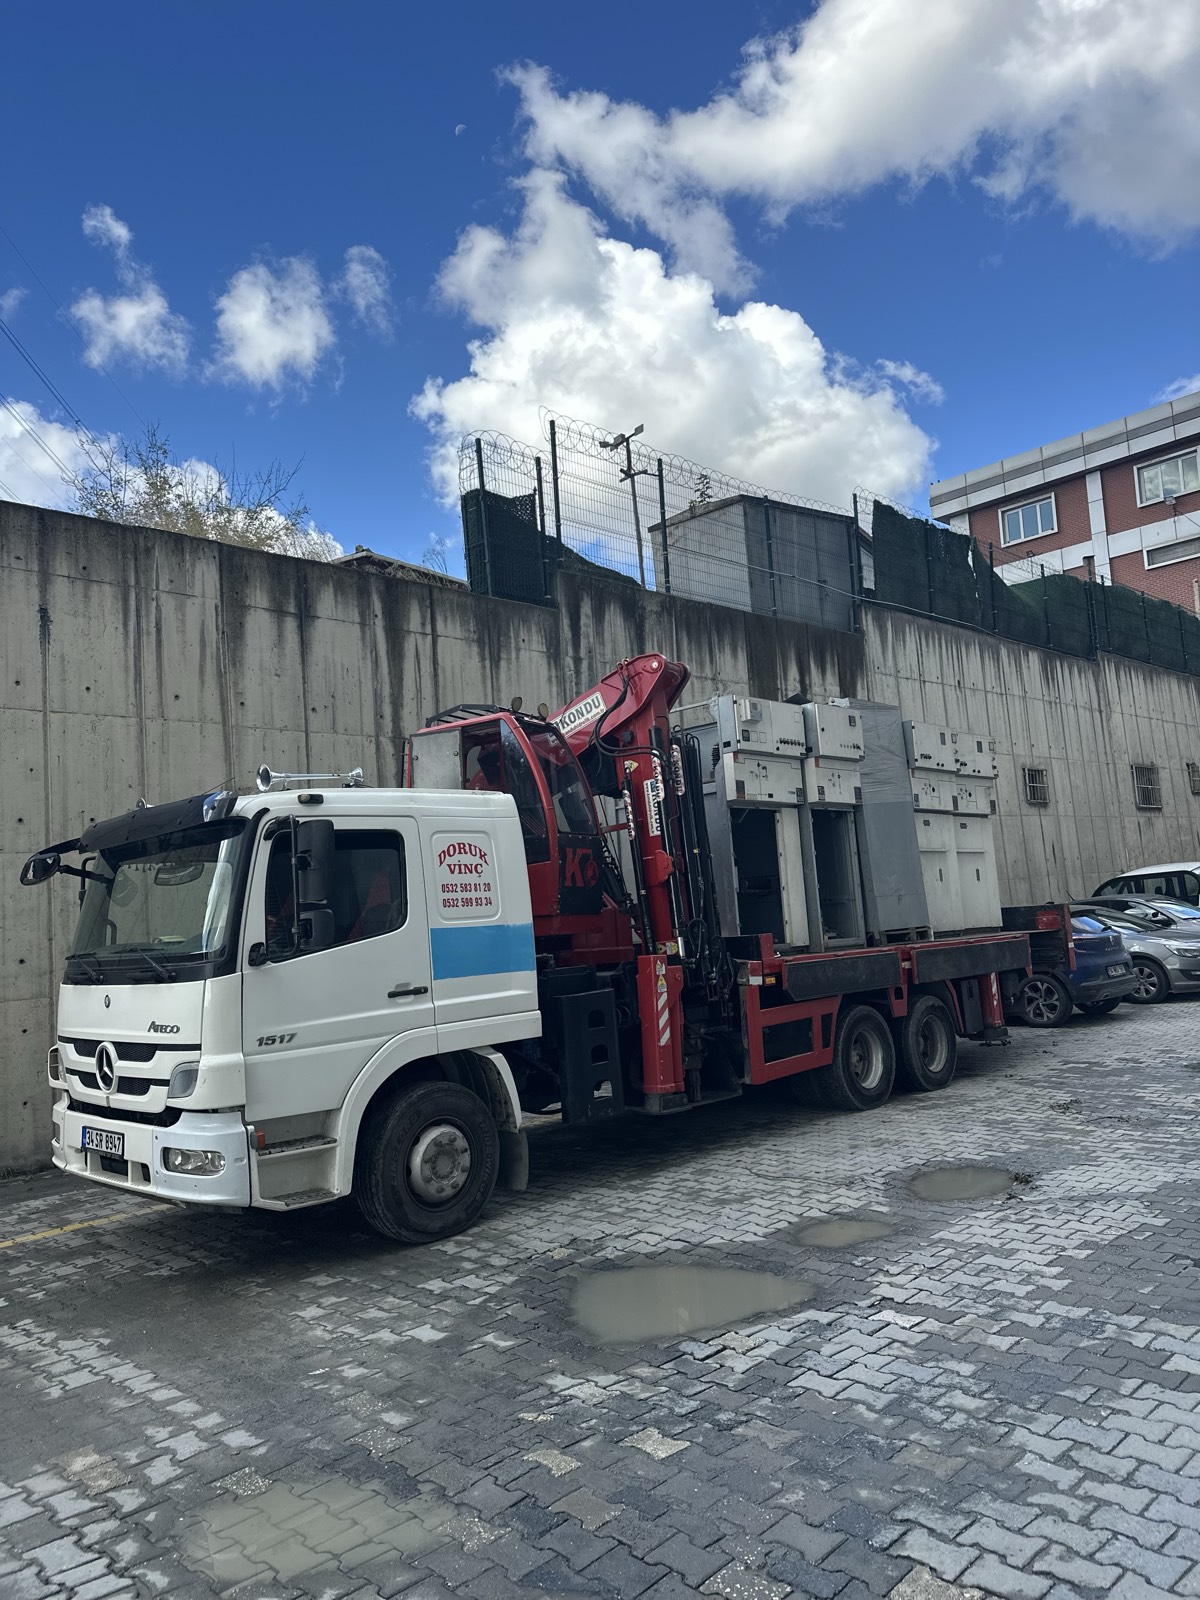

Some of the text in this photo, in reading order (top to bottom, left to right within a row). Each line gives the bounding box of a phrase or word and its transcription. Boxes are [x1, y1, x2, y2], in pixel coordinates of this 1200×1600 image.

[560, 695, 601, 729] KONDU
[673, 760, 684, 792] KONDU
[438, 842, 489, 867] DORUK
[446, 860, 483, 878] VİNÇ
[441, 883, 491, 893] 0532 583 81 20
[443, 897, 492, 908] 0532 599 93 34
[256, 1033, 297, 1047] 1517
[86, 1130, 121, 1153] 34 SR 8947
